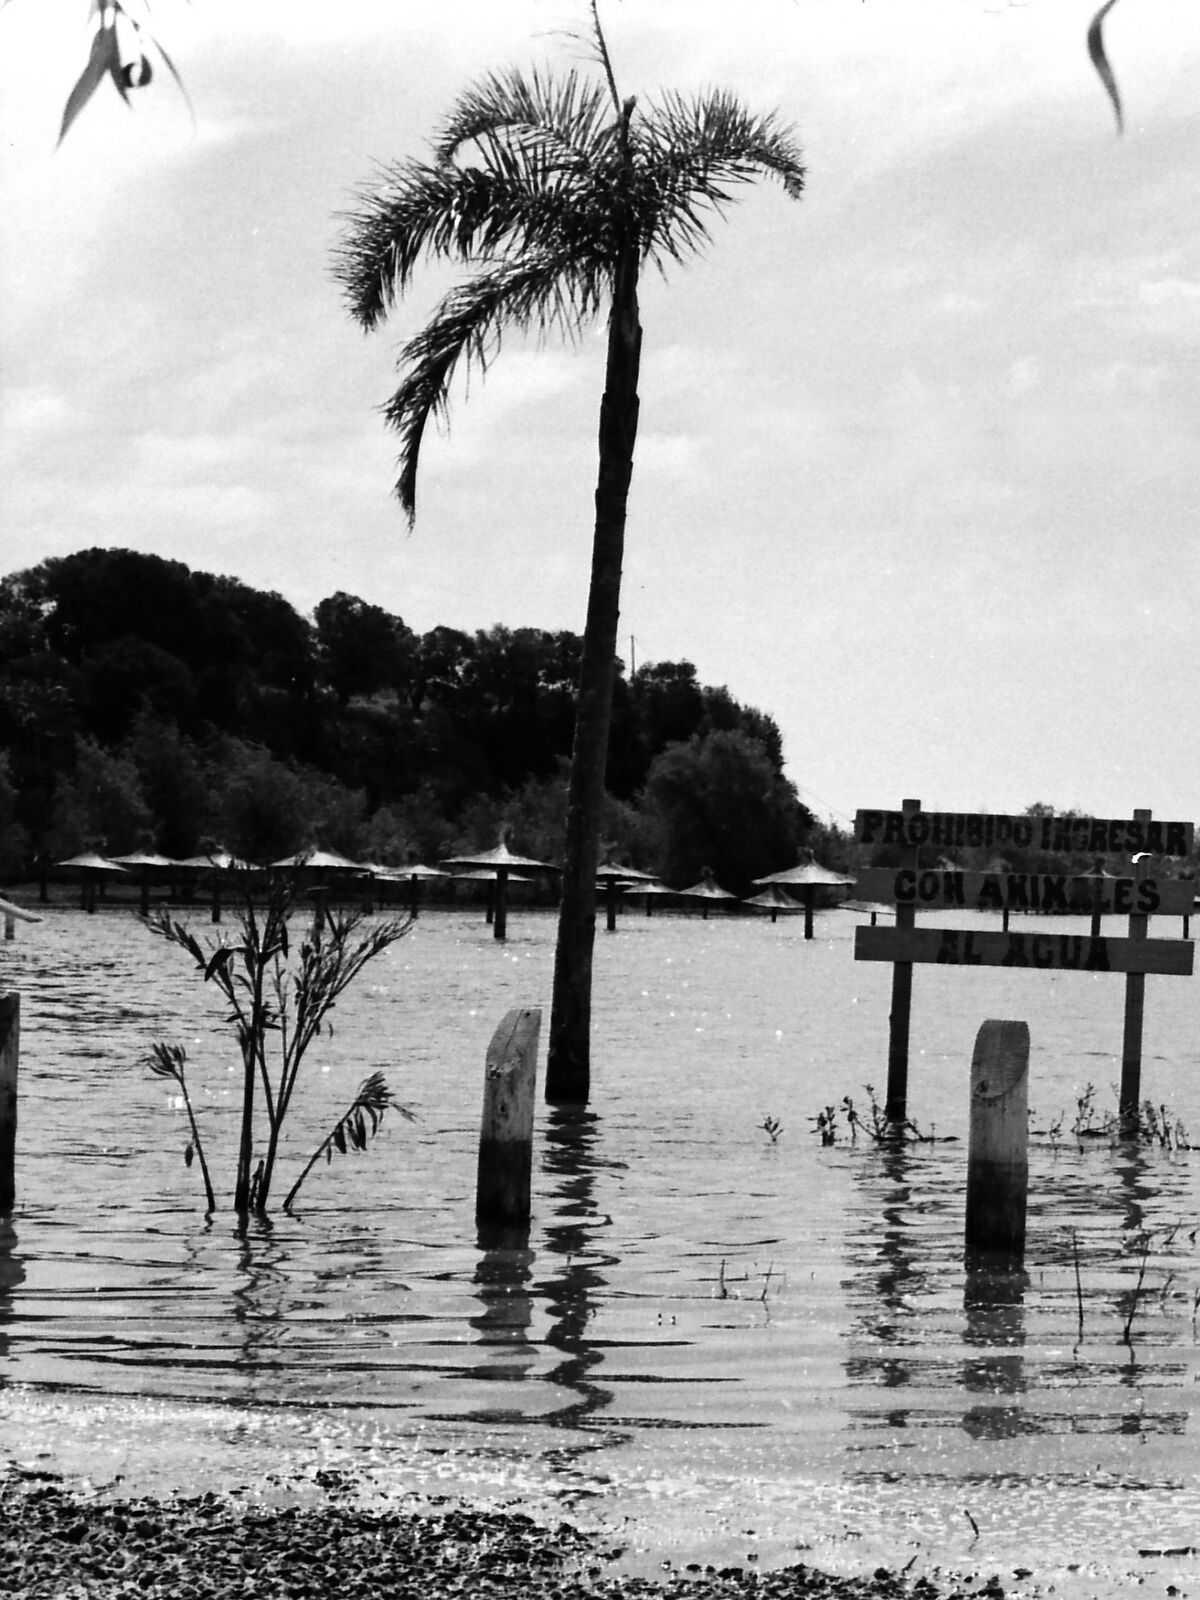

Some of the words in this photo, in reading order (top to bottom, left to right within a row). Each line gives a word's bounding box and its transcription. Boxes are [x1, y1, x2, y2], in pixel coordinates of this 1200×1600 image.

[860, 811, 1033, 849] PROHIBIDO
[1039, 817, 1188, 856] INGRESAR
[893, 870, 965, 905] CON
[936, 930, 983, 965] AL
[1002, 933, 1110, 972] AGUA
